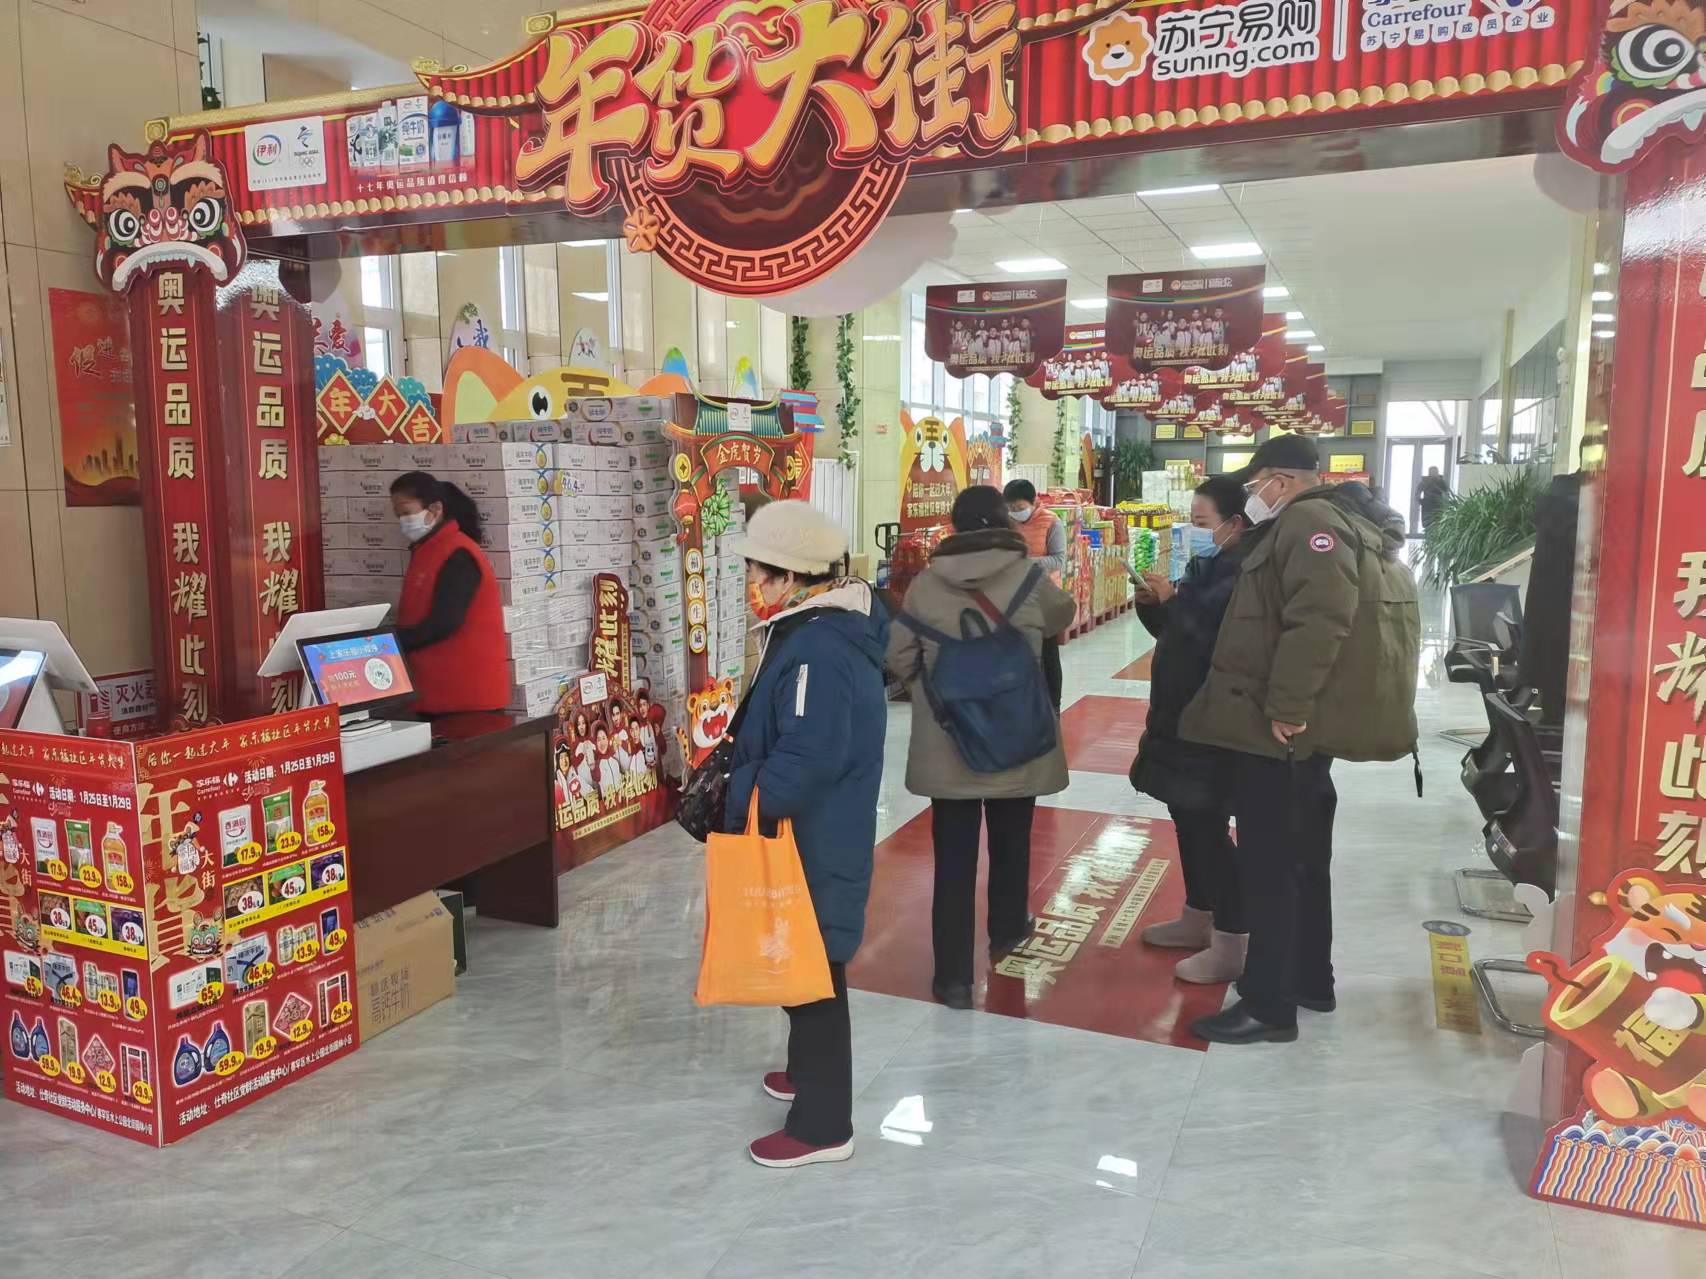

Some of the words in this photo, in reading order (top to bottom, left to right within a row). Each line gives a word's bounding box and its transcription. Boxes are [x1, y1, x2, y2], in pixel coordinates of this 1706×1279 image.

[1159, 0, 1316, 54] 苏宁易购
[1366, 11, 1549, 46] 苏宁易购成员企业
[1368, 3, 1466, 27] Carrefour
[1157, 40, 1315, 76] suning.com
[515, 0, 1018, 202] 年货大街
[256, 143, 278, 157] 伊利
[358, 173, 468, 192] 十七年奥运品质值得信赖
[158, 272, 195, 479] 奥运品质
[250, 288, 289, 480] 奥运品质
[171, 522, 208, 723] 我耀此刻
[260, 522, 299, 714] 我耀刻
[148, 738, 231, 768] 陪你一起过大年
[280, 751, 336, 773] 1月25日至1月29日
[554, 790, 601, 832] 运品质
[201, 849, 216, 890] 大街
